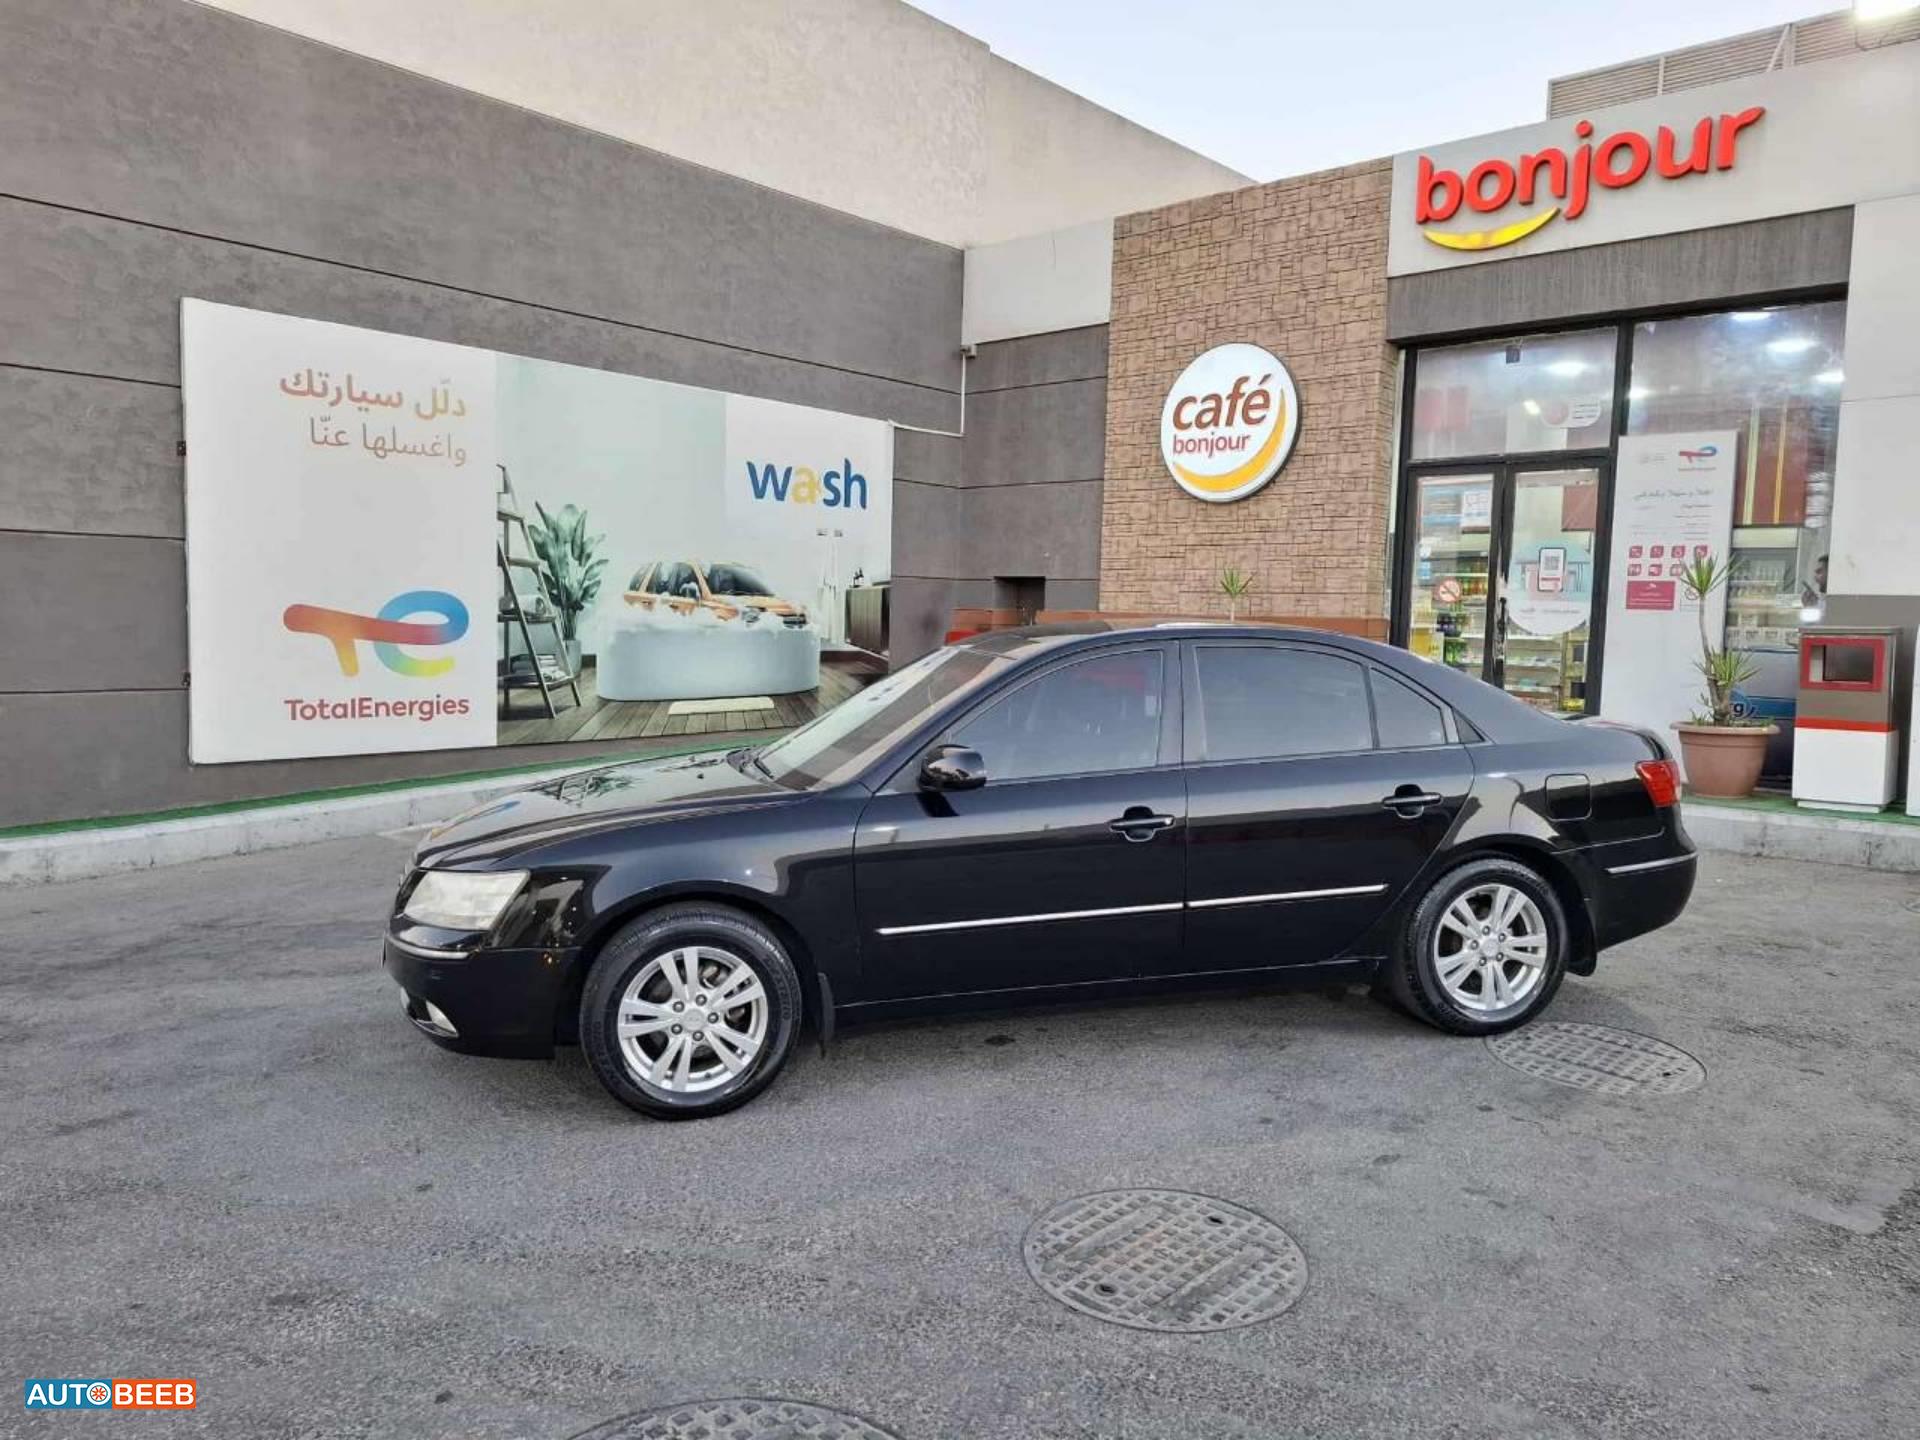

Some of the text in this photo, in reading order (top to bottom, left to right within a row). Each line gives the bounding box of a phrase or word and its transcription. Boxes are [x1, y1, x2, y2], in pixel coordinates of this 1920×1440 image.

[1416, 105, 1767, 224] bonjour
[279, 368, 403, 412] سيارتك
[1172, 373, 1272, 431] café
[362, 422, 467, 468] واغسلها
[1172, 431, 1250, 458] bonjour
[746, 457, 867, 510] wash
[284, 694, 470, 722] TotalEnergies
